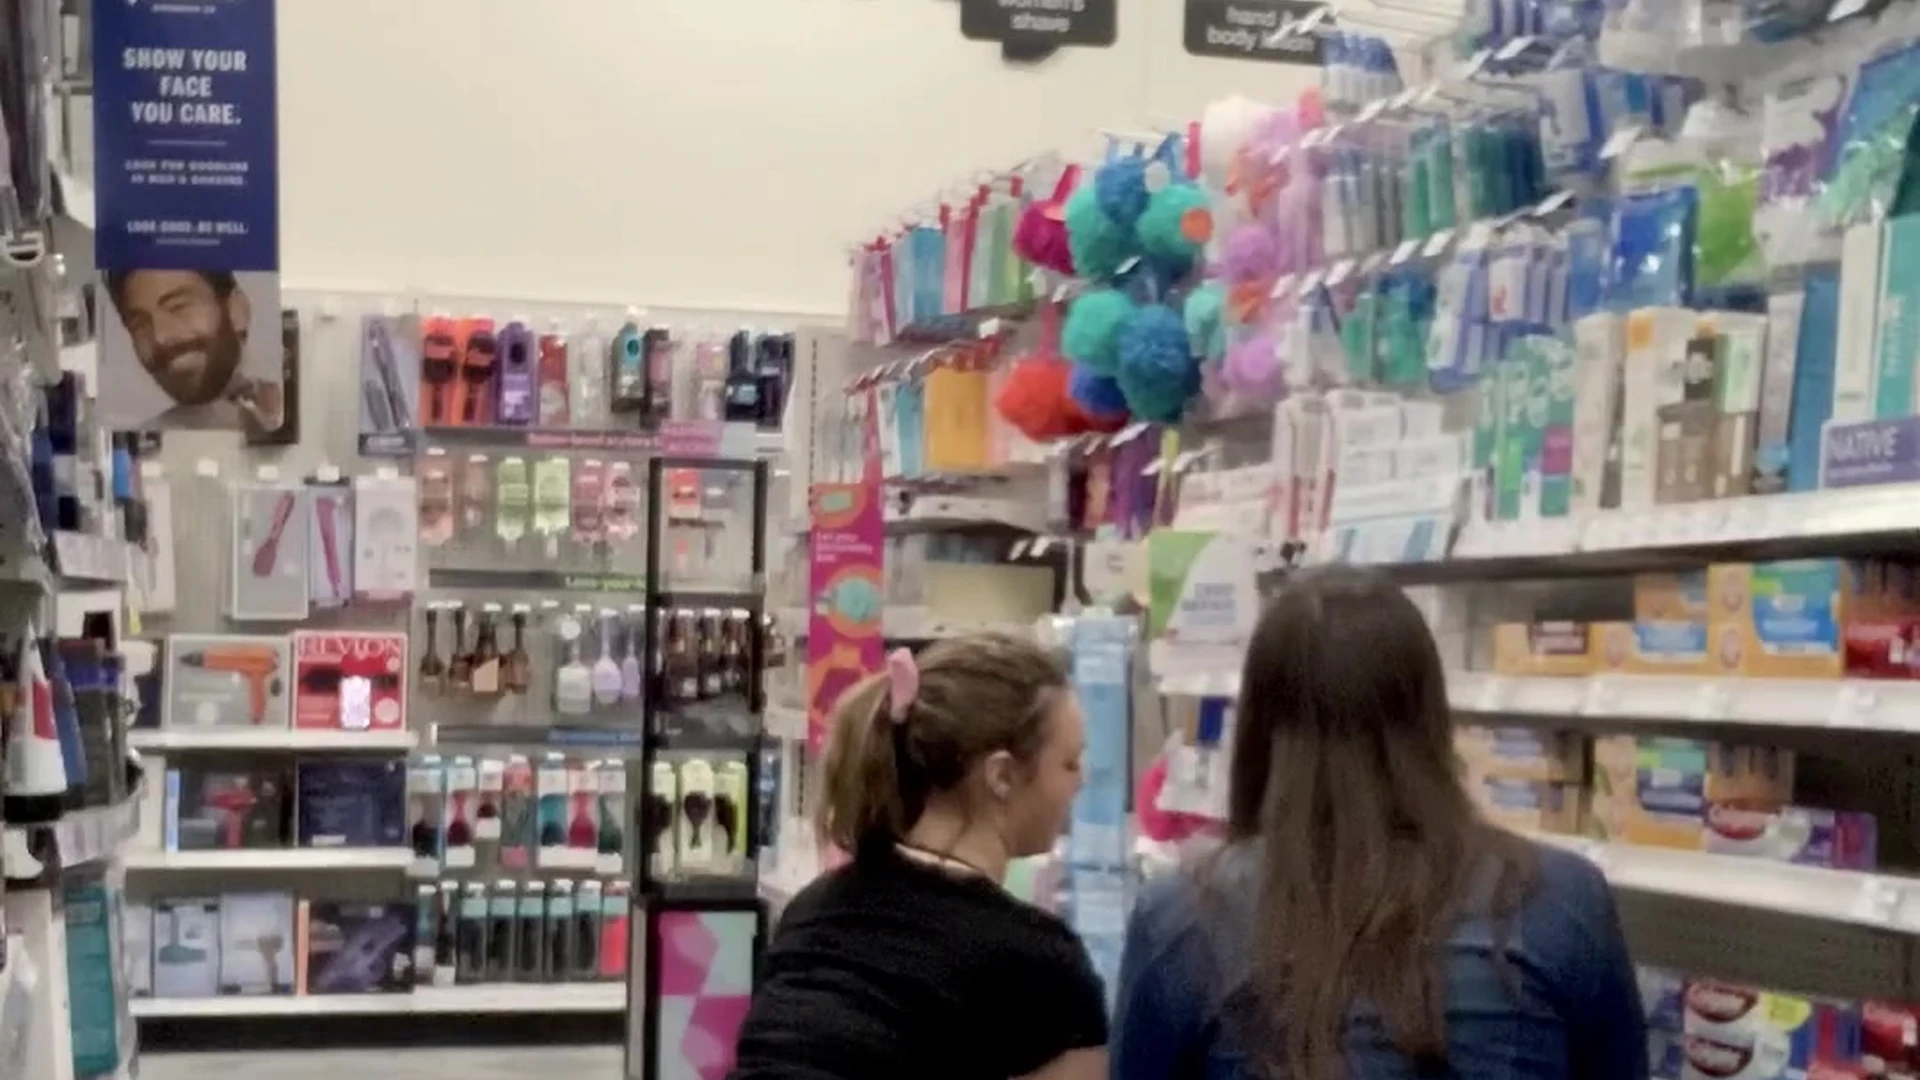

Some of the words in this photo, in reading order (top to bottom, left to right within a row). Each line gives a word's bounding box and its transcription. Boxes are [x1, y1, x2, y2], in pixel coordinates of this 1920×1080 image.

[998, 0, 1085, 12] womens
[1226, 6, 1277, 27] hand
[1010, 13, 1069, 33] shave
[1206, 24, 1256, 52] body
[122, 47, 185, 69] SHOW
[192, 49, 248, 71] YOUR
[158, 75, 212, 97] FACE
[131, 102, 173, 124] YOU
[180, 103, 242, 125] CARE.
[1828, 425, 1899, 460] NATIVE
[297, 636, 402, 660] REVLON
